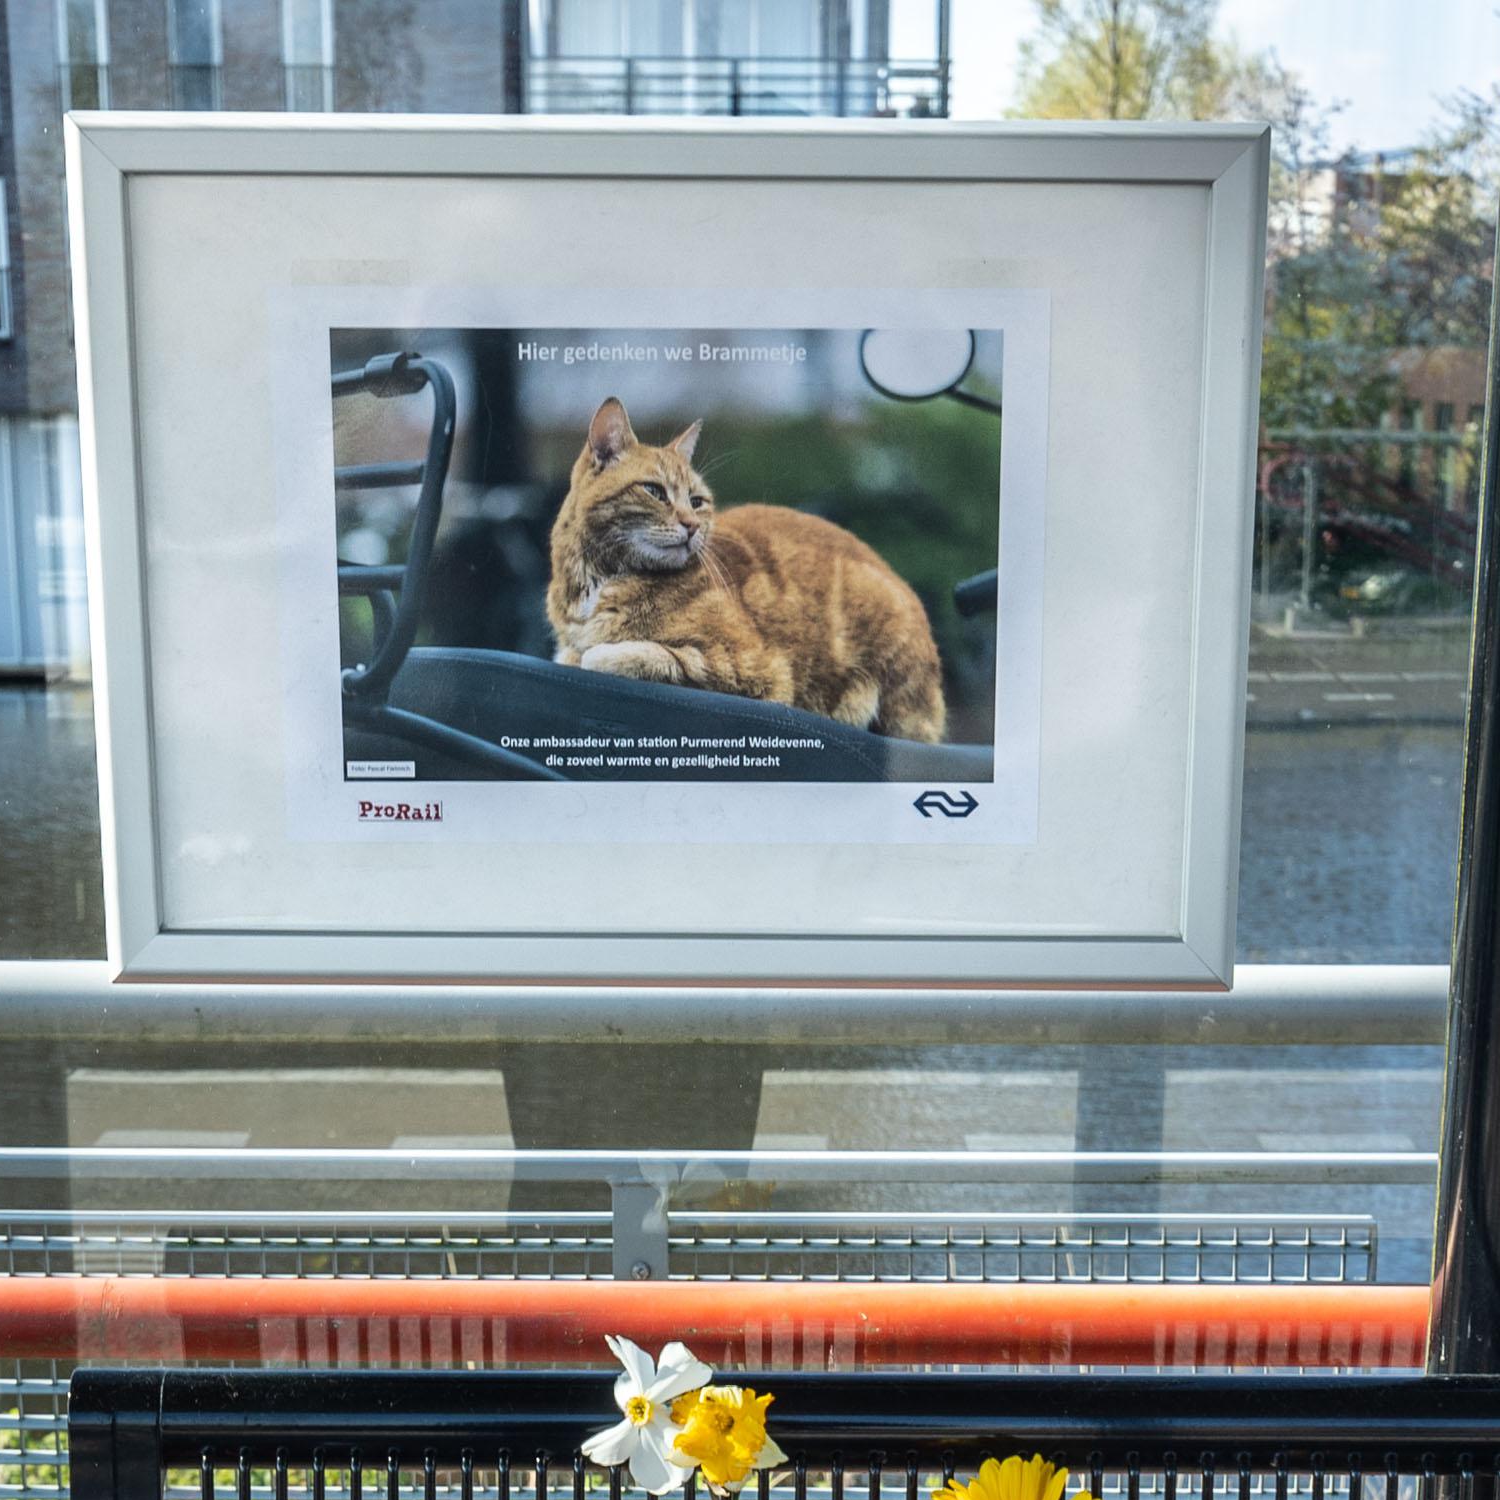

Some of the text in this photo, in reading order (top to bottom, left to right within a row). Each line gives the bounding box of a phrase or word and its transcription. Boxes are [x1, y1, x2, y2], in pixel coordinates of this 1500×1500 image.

[518, 343, 807, 365] Hier gedenken we Brammetje
[500, 736, 825, 750] Onze ambassadeur van station Purmerend Weidevenne,
[546, 755, 780, 769] die zoveel warmte en gezelligheid bracht
[359, 801, 443, 821] ProRail
